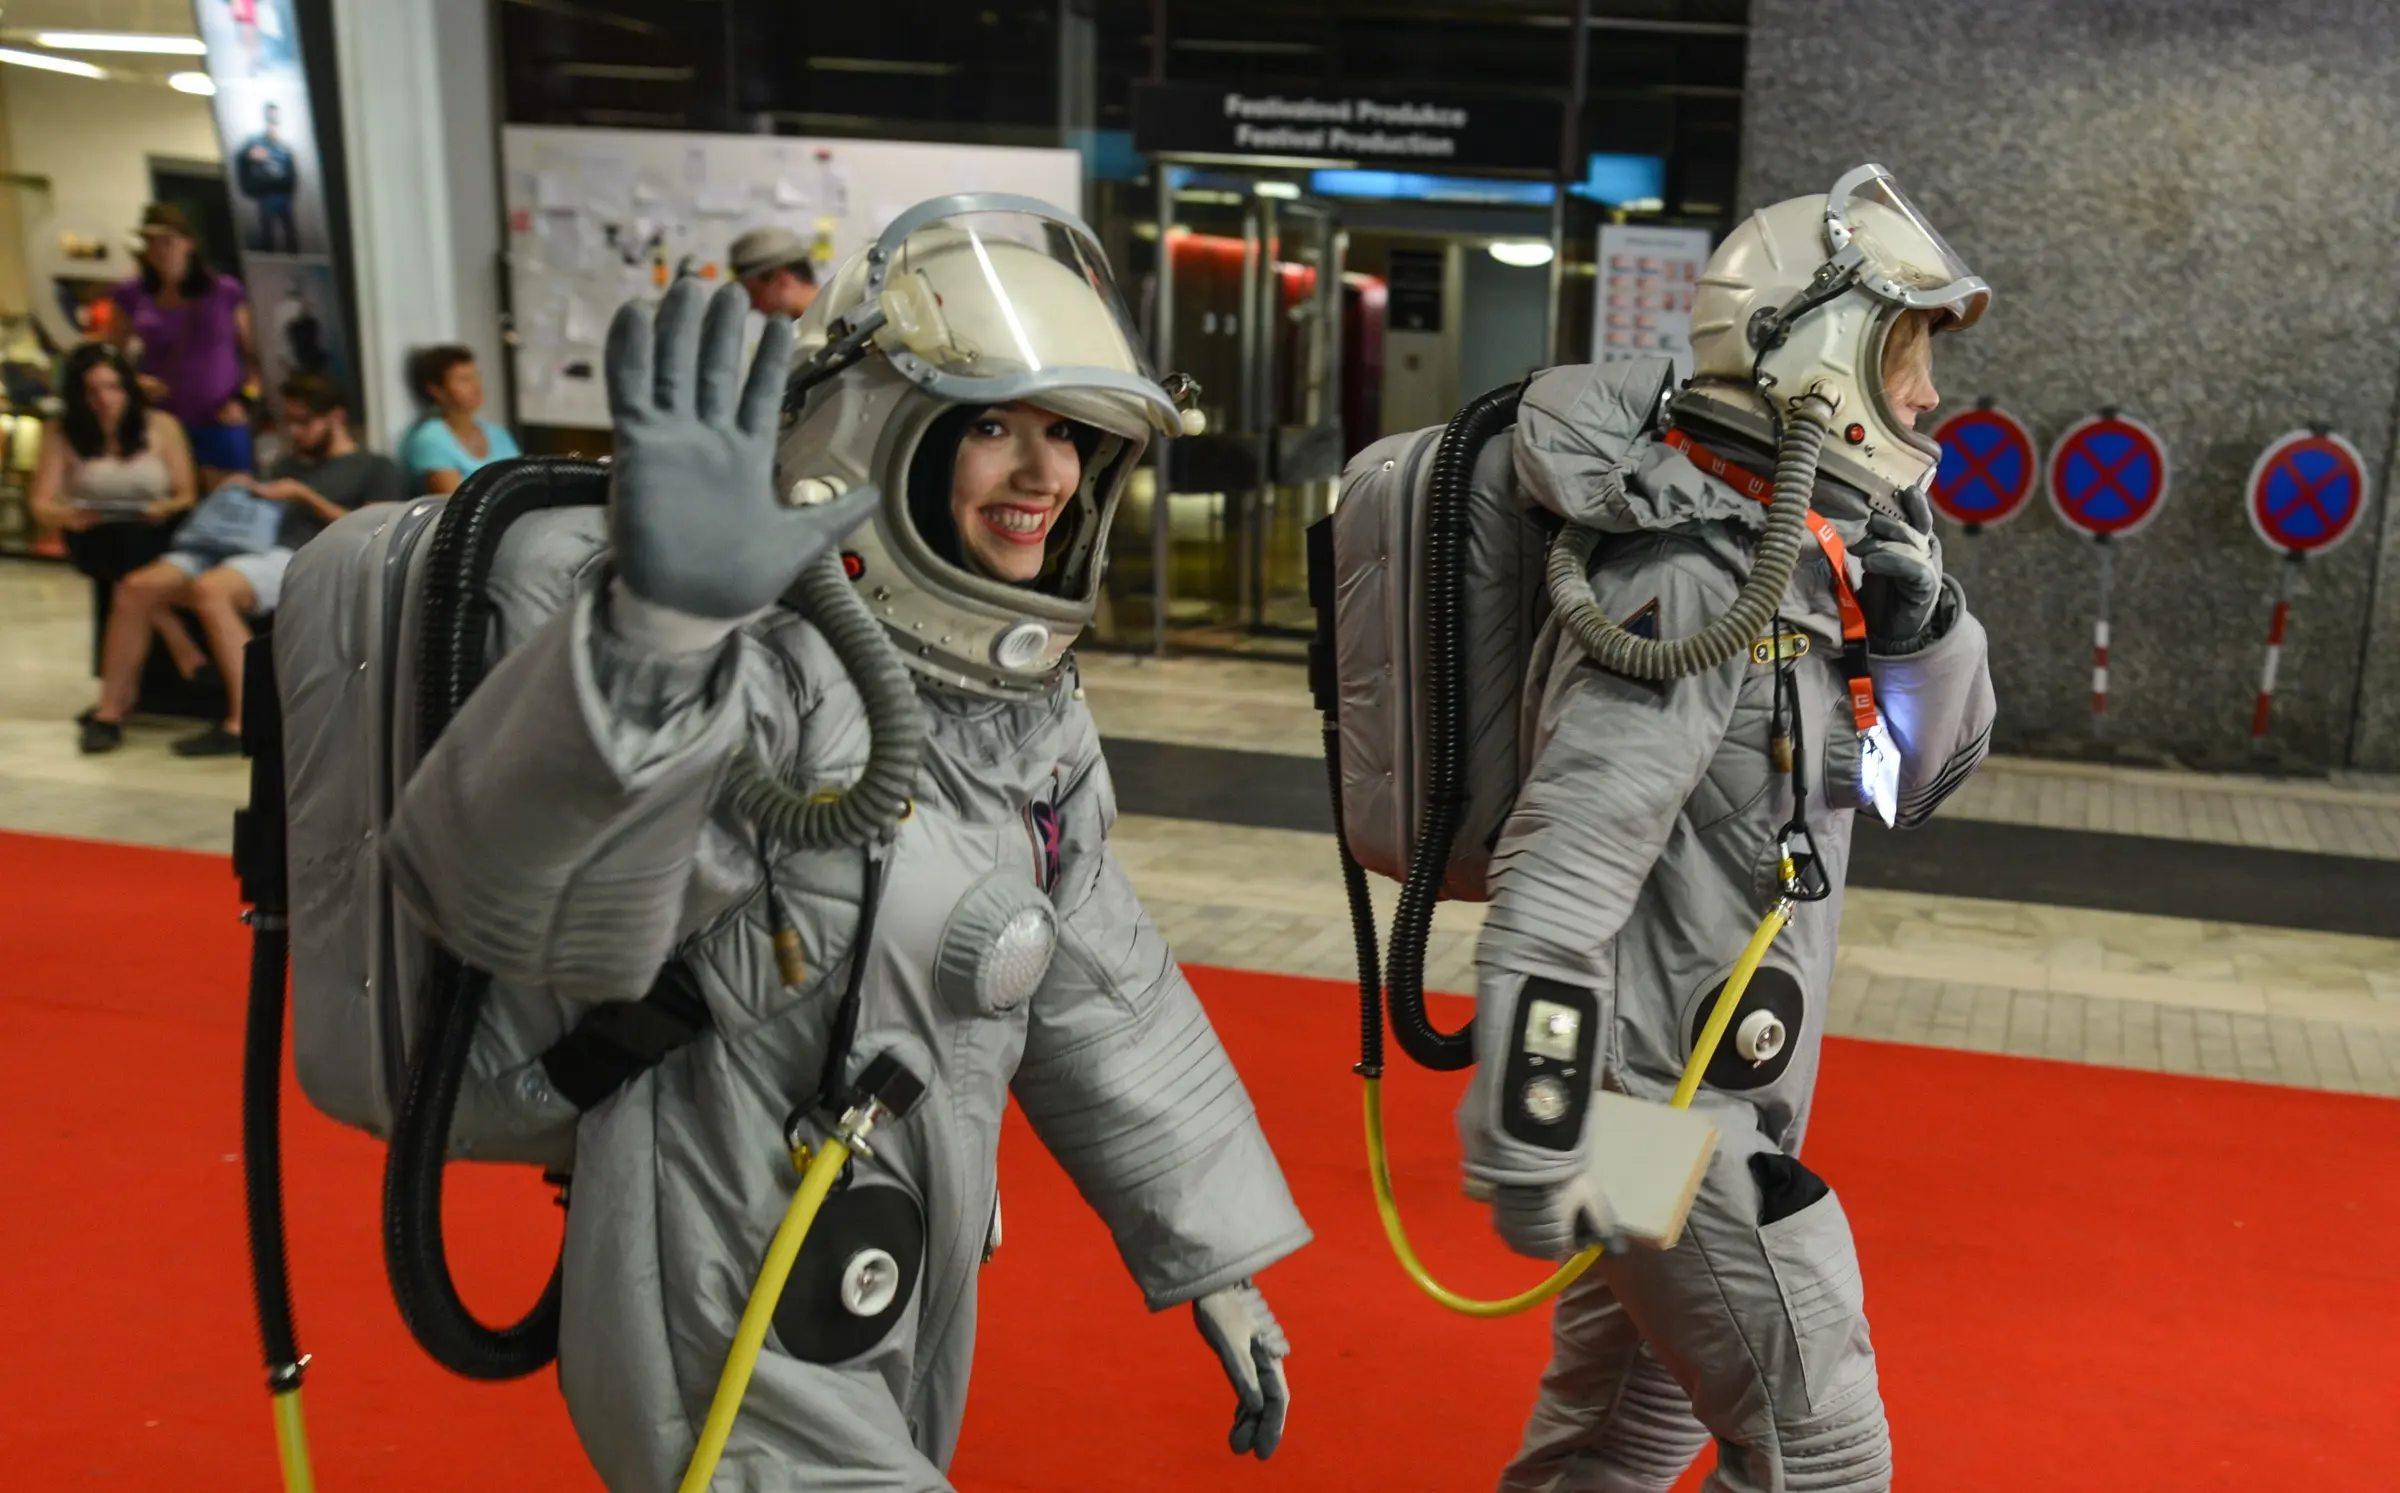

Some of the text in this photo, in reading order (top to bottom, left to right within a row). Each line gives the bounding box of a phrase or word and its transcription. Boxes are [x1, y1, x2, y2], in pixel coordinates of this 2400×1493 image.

[1357, 100, 1466, 125] Produkce
[1236, 124, 1454, 153] Festival Production
